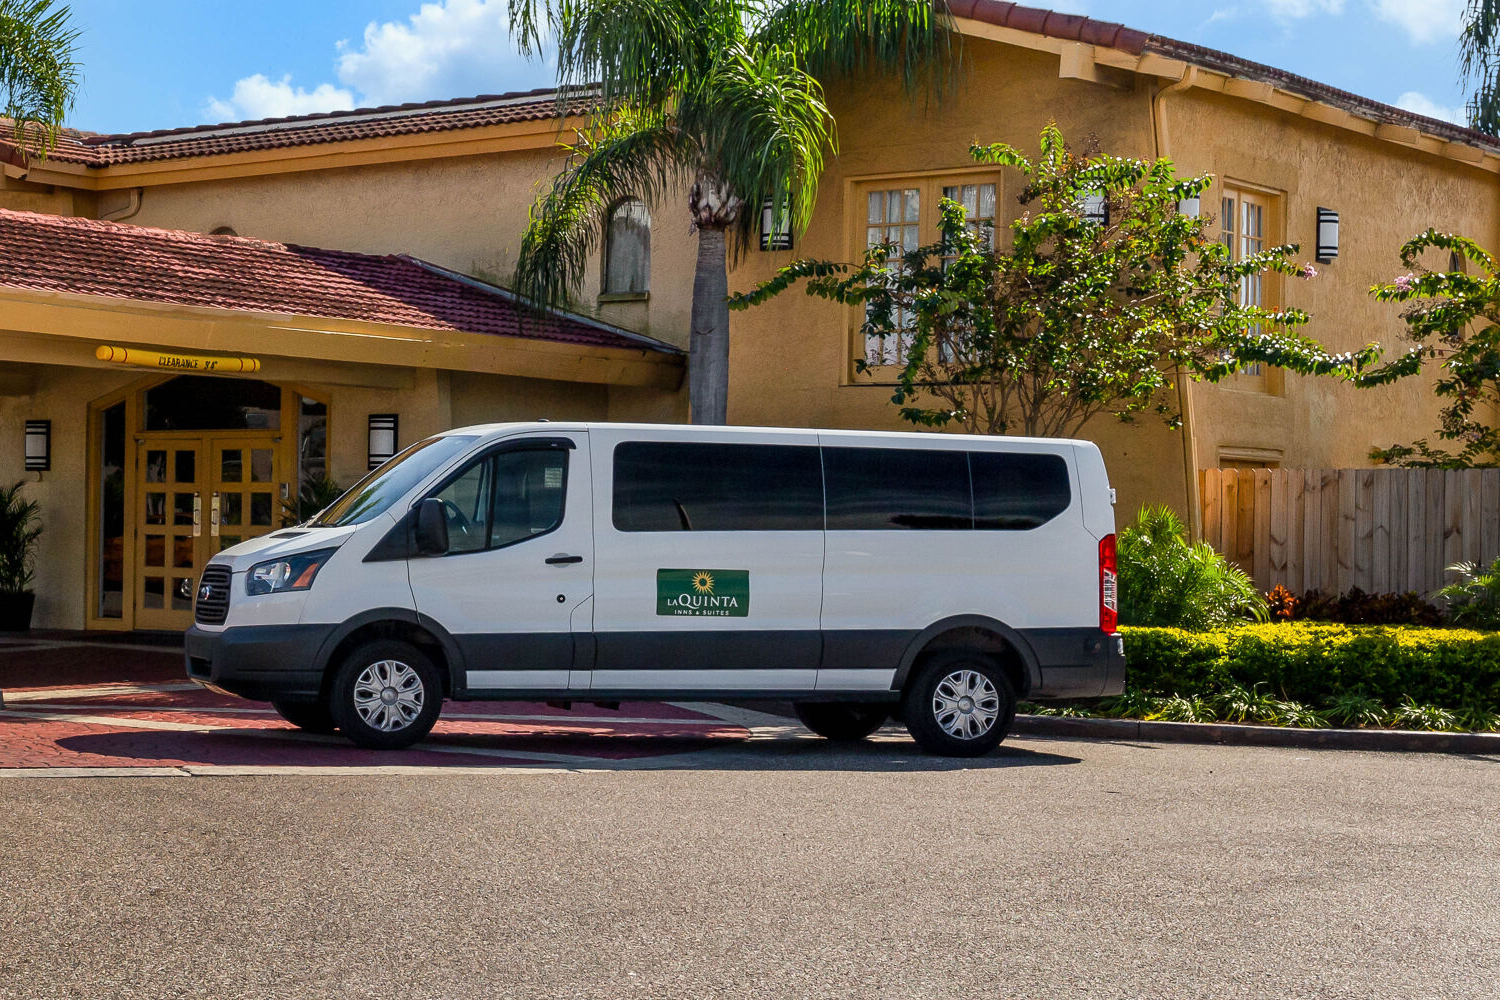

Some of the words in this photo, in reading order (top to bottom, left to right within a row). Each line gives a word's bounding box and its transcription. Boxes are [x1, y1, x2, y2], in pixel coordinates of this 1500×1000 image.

[158, 356, 199, 369] CLEARANCE
[667, 598, 678, 606] LA
[678, 593, 739, 610] QUINTA
